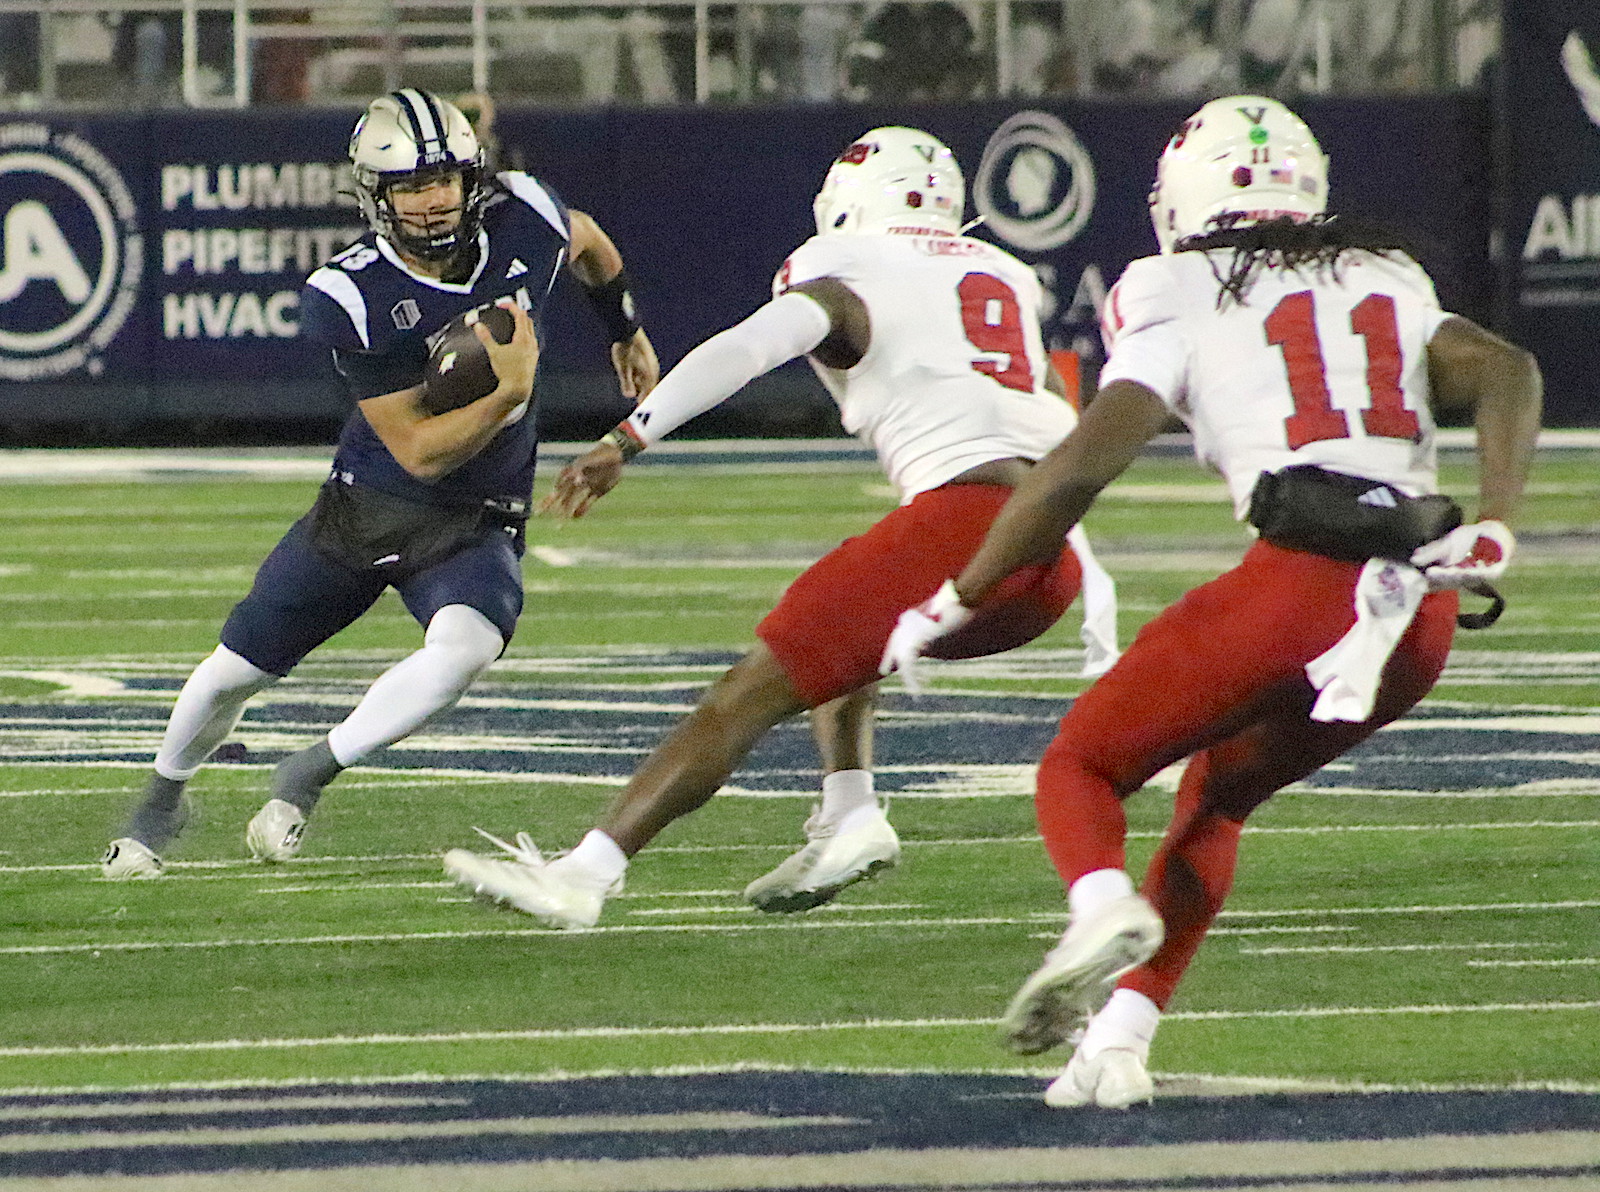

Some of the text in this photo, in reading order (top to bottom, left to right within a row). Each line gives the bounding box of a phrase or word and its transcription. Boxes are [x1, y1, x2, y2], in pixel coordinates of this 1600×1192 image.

[1235, 107, 1268, 125] V
[162, 291, 301, 340] HVAC
[957, 271, 1035, 394] 9
[1263, 289, 1421, 450] 11
